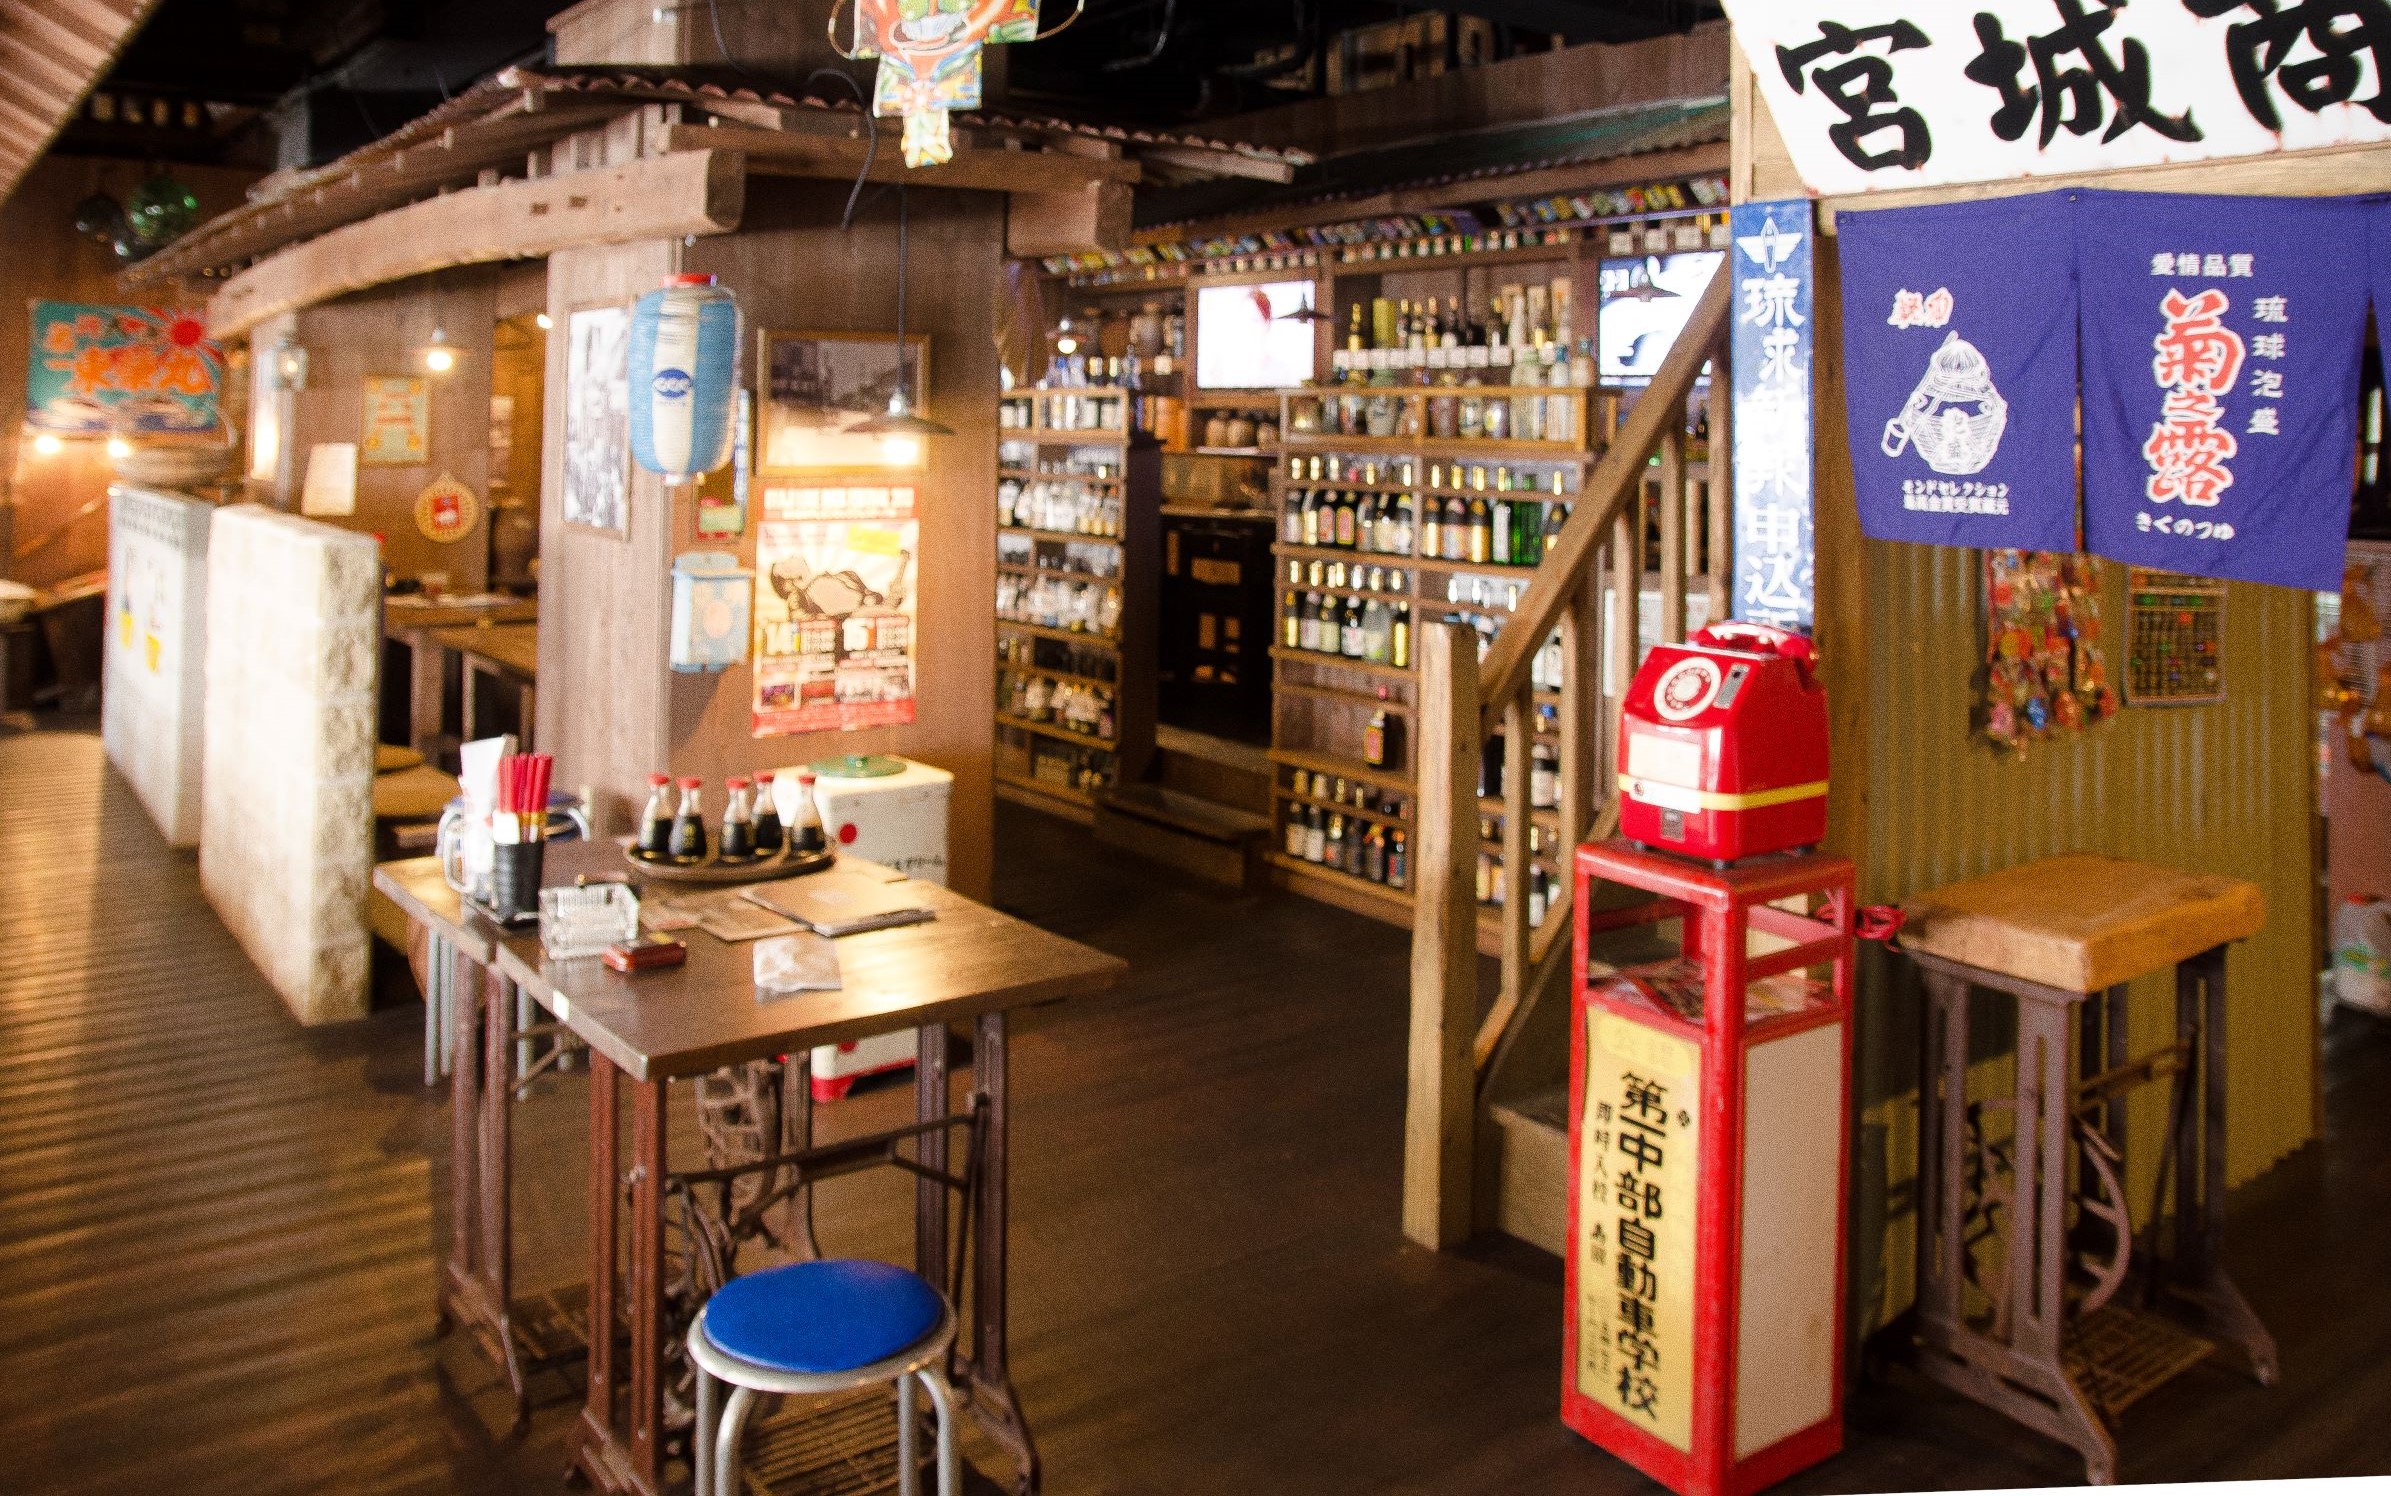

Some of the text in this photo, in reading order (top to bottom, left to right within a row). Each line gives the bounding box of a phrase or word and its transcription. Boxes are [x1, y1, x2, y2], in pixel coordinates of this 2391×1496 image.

[2151, 253, 2254, 277] 愛情品質
[2143, 288, 2246, 506] 菊之露
[2246, 295, 2288, 435] 琉球泡盛
[2134, 511, 2235, 540] きくのつゆ
